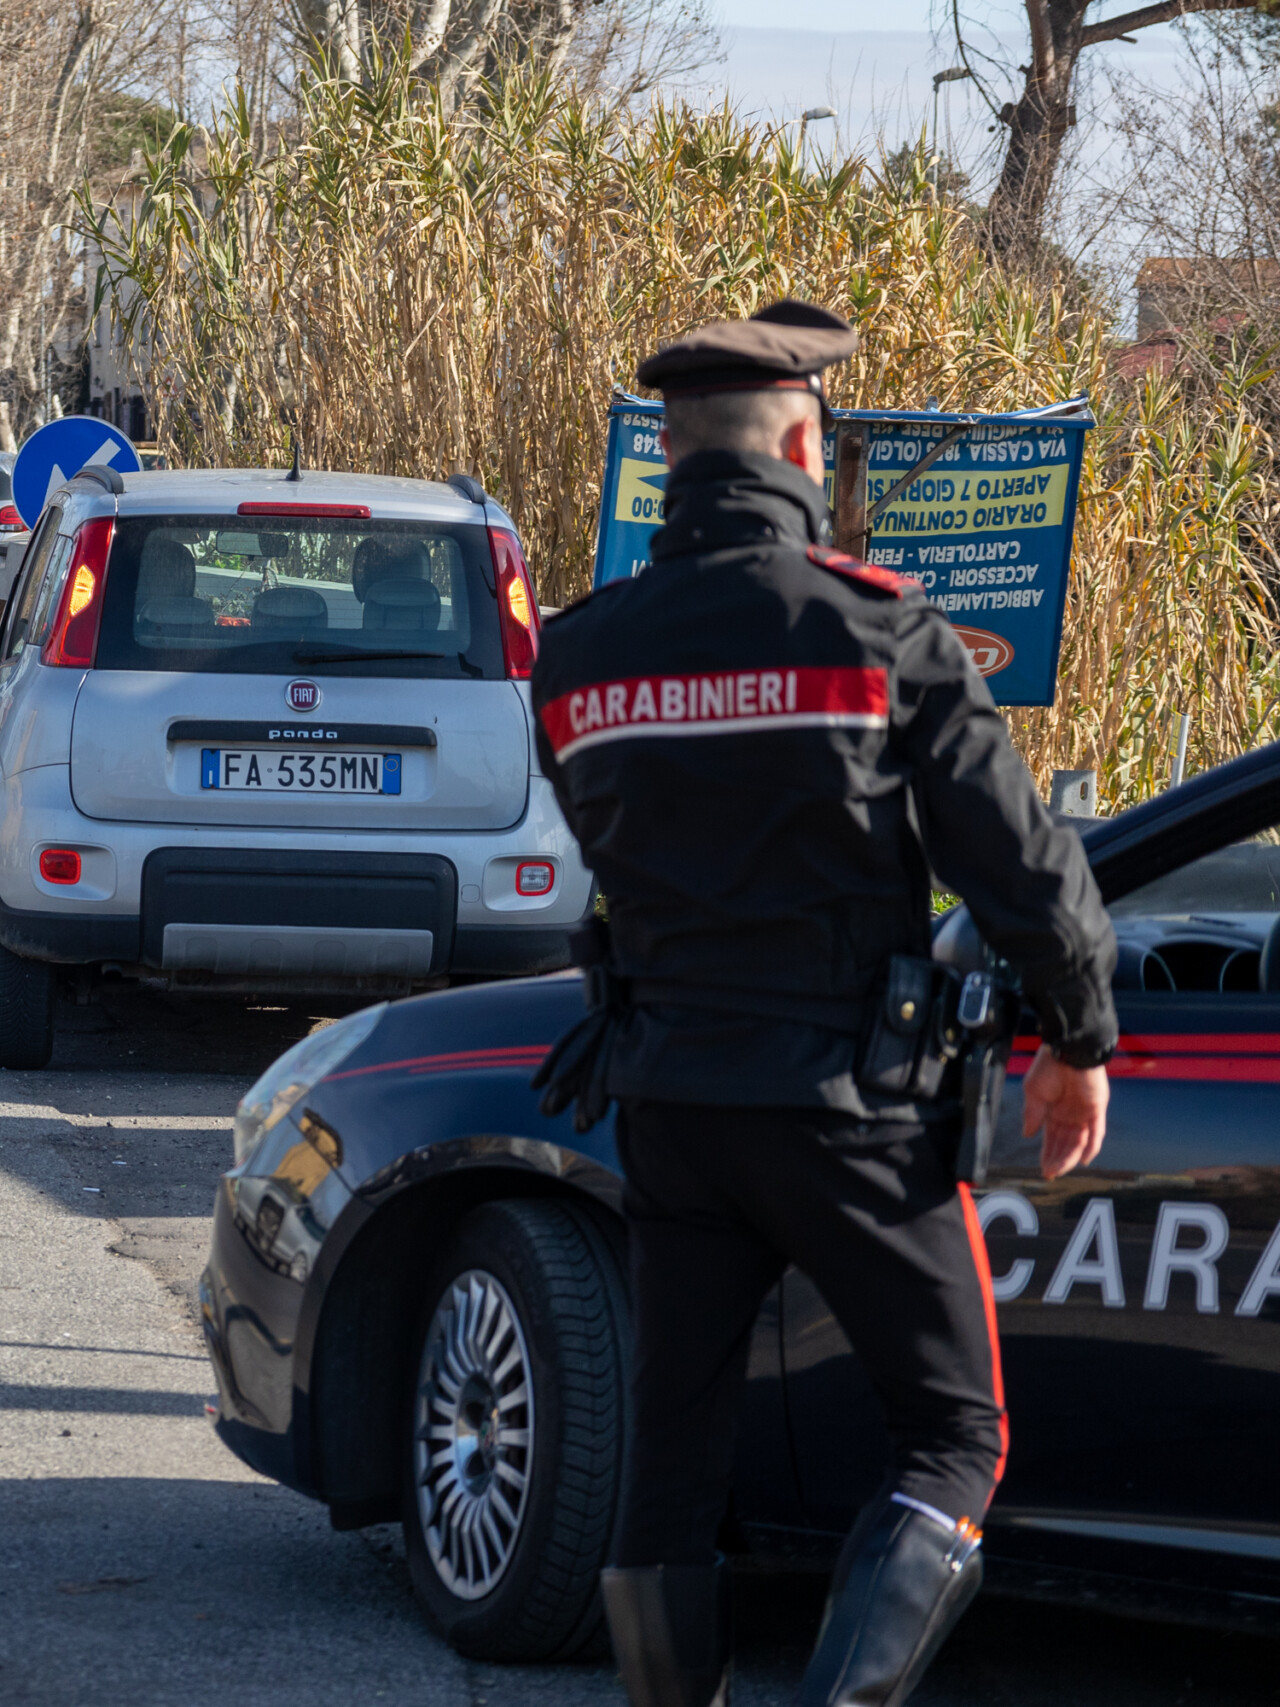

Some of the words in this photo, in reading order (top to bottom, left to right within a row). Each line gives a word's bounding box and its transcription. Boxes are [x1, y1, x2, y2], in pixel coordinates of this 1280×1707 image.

[966, 441, 1034, 462] CASSIA,
[1038, 438, 1067, 459] VIA
[960, 480, 971, 501] 7
[977, 473, 1051, 501] APERTO
[972, 502, 1047, 528] ORARIO
[918, 541, 1021, 564] CARTOLERIA
[949, 564, 1040, 587] ACCESSORI
[927, 589, 1045, 611] ABBIGLIAMENT
[294, 687, 315, 703] FIAT
[569, 670, 798, 735] CARABINIERI
[268, 729, 338, 739] panda
[224, 754, 262, 786] FA
[277, 755, 379, 790] 535MN
[974, 1190, 1280, 1317] CARA
